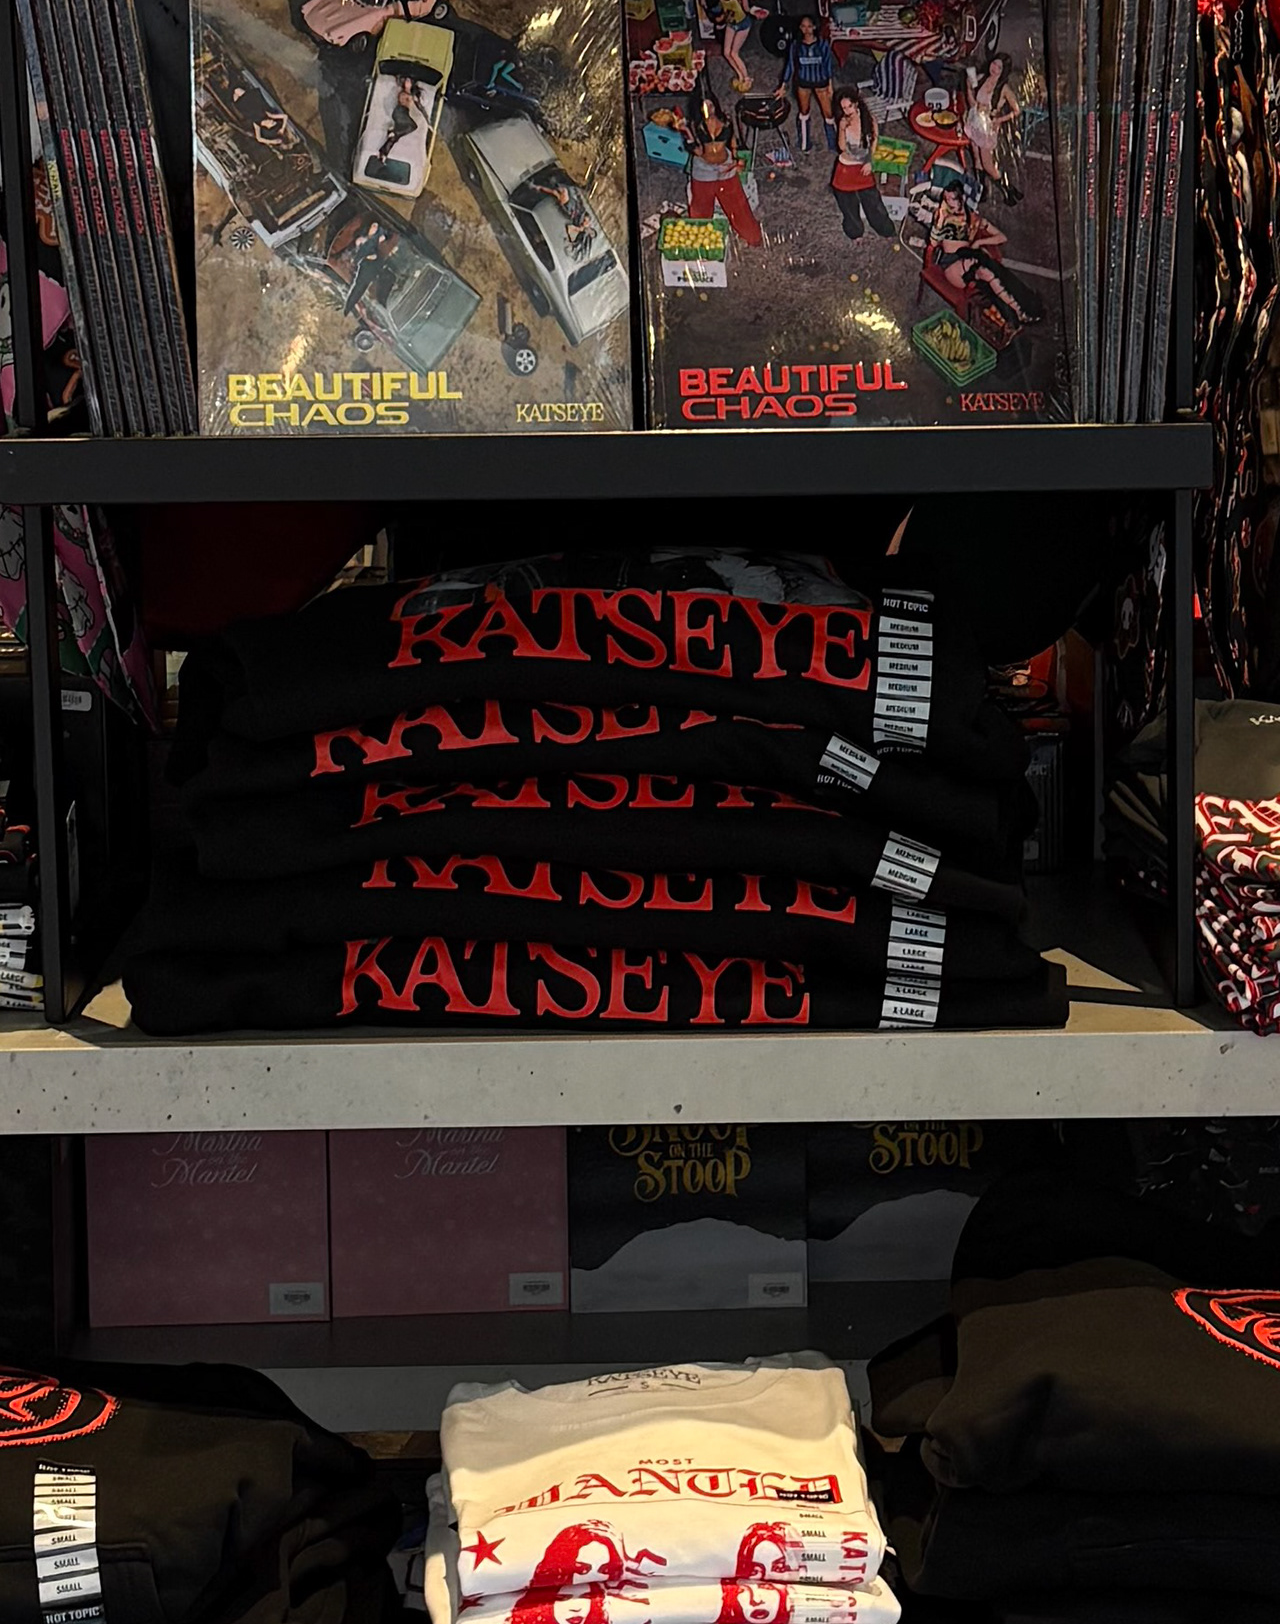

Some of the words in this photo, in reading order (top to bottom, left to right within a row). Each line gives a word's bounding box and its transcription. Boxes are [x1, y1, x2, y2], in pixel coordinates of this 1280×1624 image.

[229, 372, 462, 401] BEAUTIFUL
[680, 363, 908, 397] BEAUTIFUL
[682, 394, 859, 422] CHAOS
[960, 391, 1045, 412] KATSEYE
[230, 402, 410, 427] CHAOS
[516, 403, 605, 423] KATSEYE
[883, 597, 900, 609] HOT
[903, 600, 929, 613] TOPIC
[890, 623, 919, 633] MEDIUM
[387, 586, 873, 691] KATSEYE
[890, 642, 919, 650] MEDIUM
[889, 663, 918, 672] MEDIUM
[888, 683, 918, 692] MEDIUM
[886, 705, 916, 714] MEDIUM
[839, 744, 867, 763] MEDIUM
[888, 868, 918, 884] MEDIUM
[904, 927, 929, 938] LARGE
[902, 947, 927, 958] LARGE
[335, 937, 812, 1025] KATSEYE
[669, 1143, 687, 1158] ON
[689, 1142, 715, 1158] THE
[868, 1125, 984, 1175] STOOP
[394, 1148, 500, 1179] Mantel
[151, 1158, 258, 1188] Mantel
[634, 1148, 752, 1203] STOOP
[638, 1456, 694, 1467] MOST
[51, 1535, 77, 1545] SMALL
[801, 1530, 826, 1538] SMALL
[54, 1557, 80, 1569] SMALL
[801, 1553, 826, 1561] SMALL
[56, 1583, 82, 1594] SMALL
[45, 1613, 67, 1624] HOT
[68, 1606, 100, 1621] TOPIC
